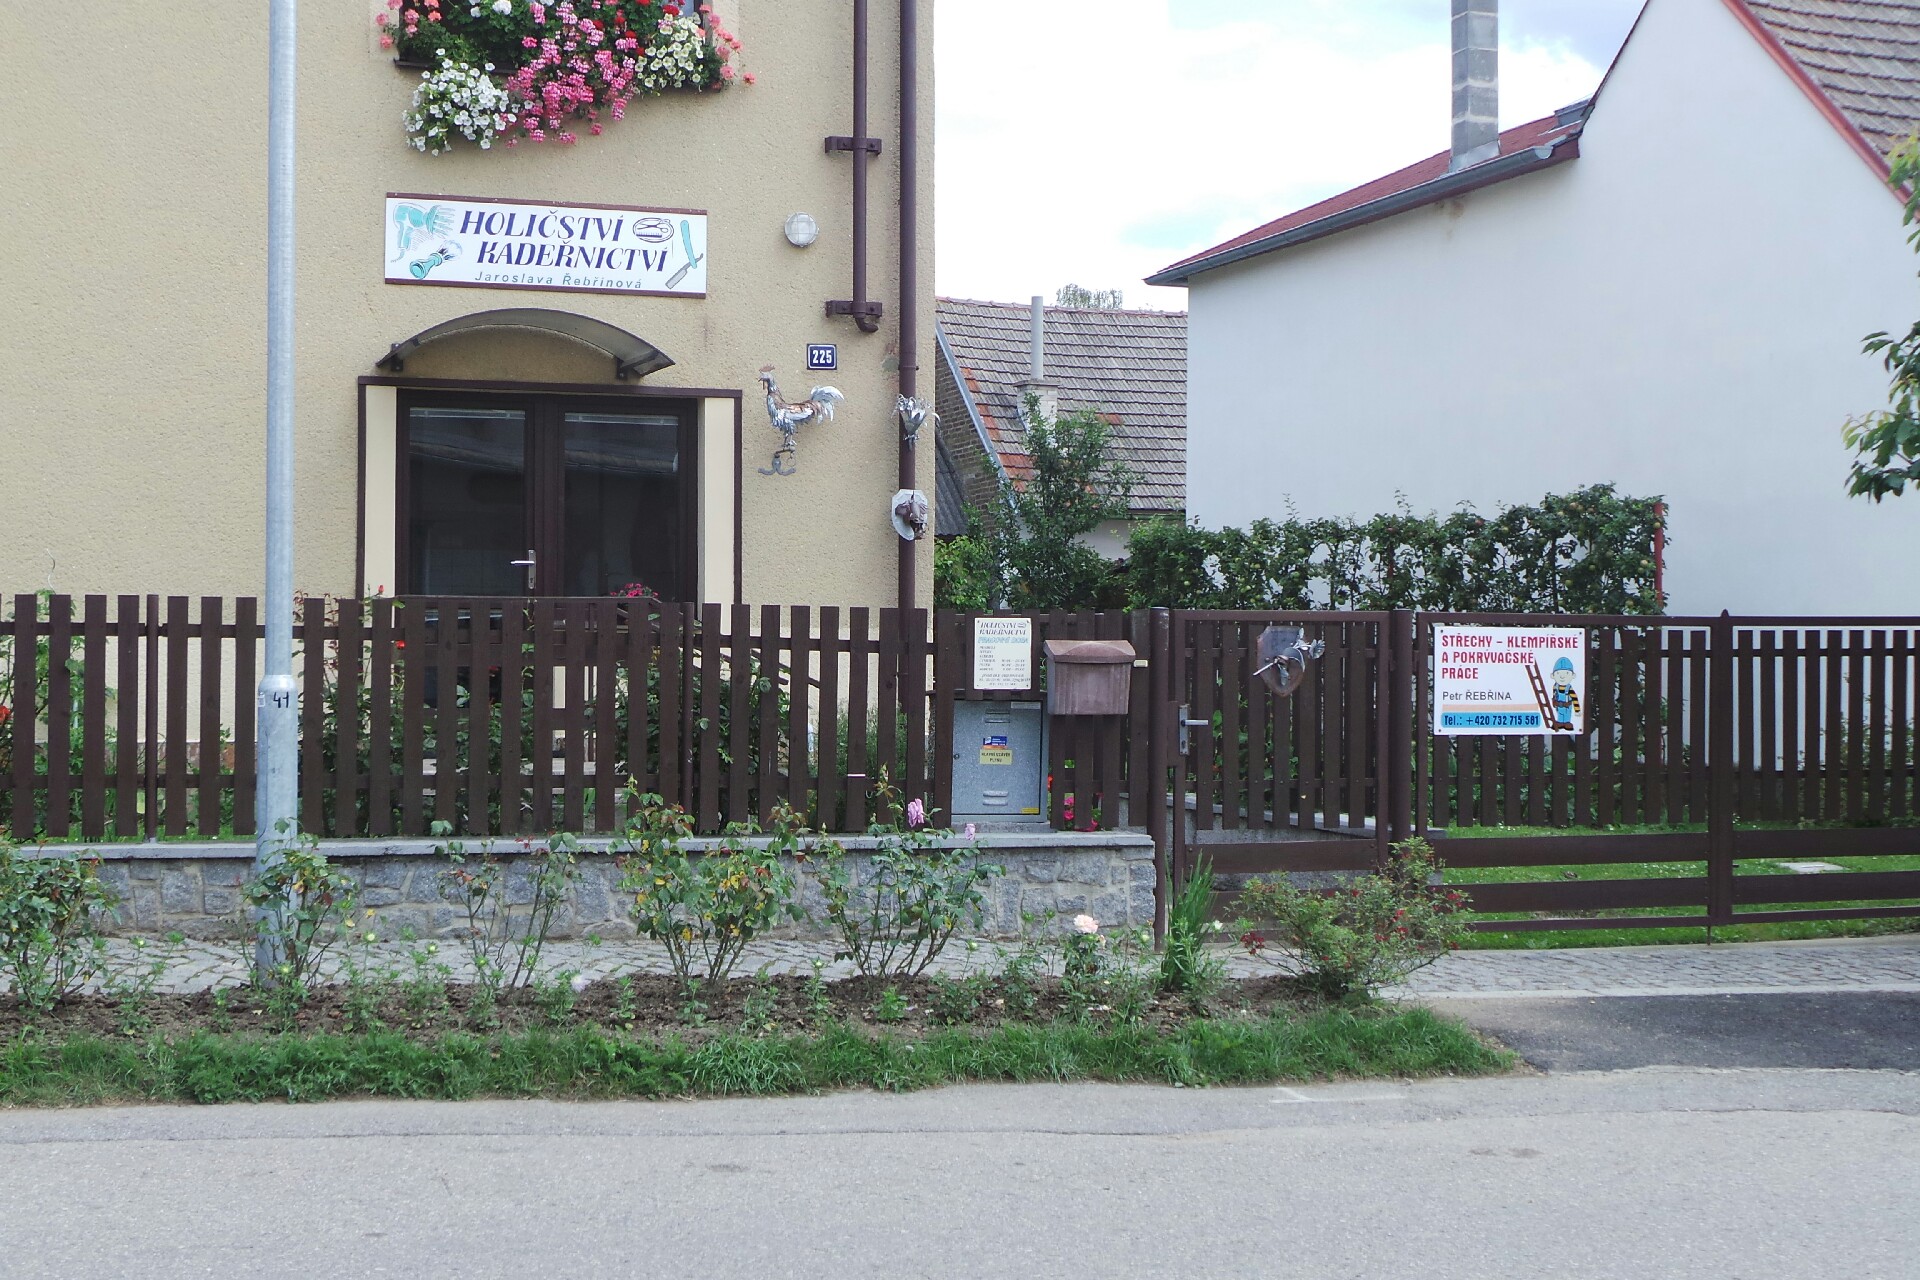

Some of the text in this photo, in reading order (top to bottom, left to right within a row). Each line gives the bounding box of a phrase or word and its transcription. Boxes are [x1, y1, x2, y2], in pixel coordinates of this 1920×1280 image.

[460, 210, 624, 242] HOLIČSTVÍ
[477, 240, 668, 272] KADEŘNICTVÍ
[475, 271, 642, 289] Jaroslava Řebřinová
[812, 349, 832, 364] 225
[1442, 632, 1492, 648] STŘECHY
[1507, 634, 1579, 649] KLEMPÍŘSKÉ
[1442, 649, 1534, 664] A POKRÝVAČSKÉ
[1442, 665, 1479, 680] PRÁCE
[1442, 689, 1512, 701] Petr ŘEBŘINA
[1444, 715, 1539, 726] Tel.: +420 732 715 581
